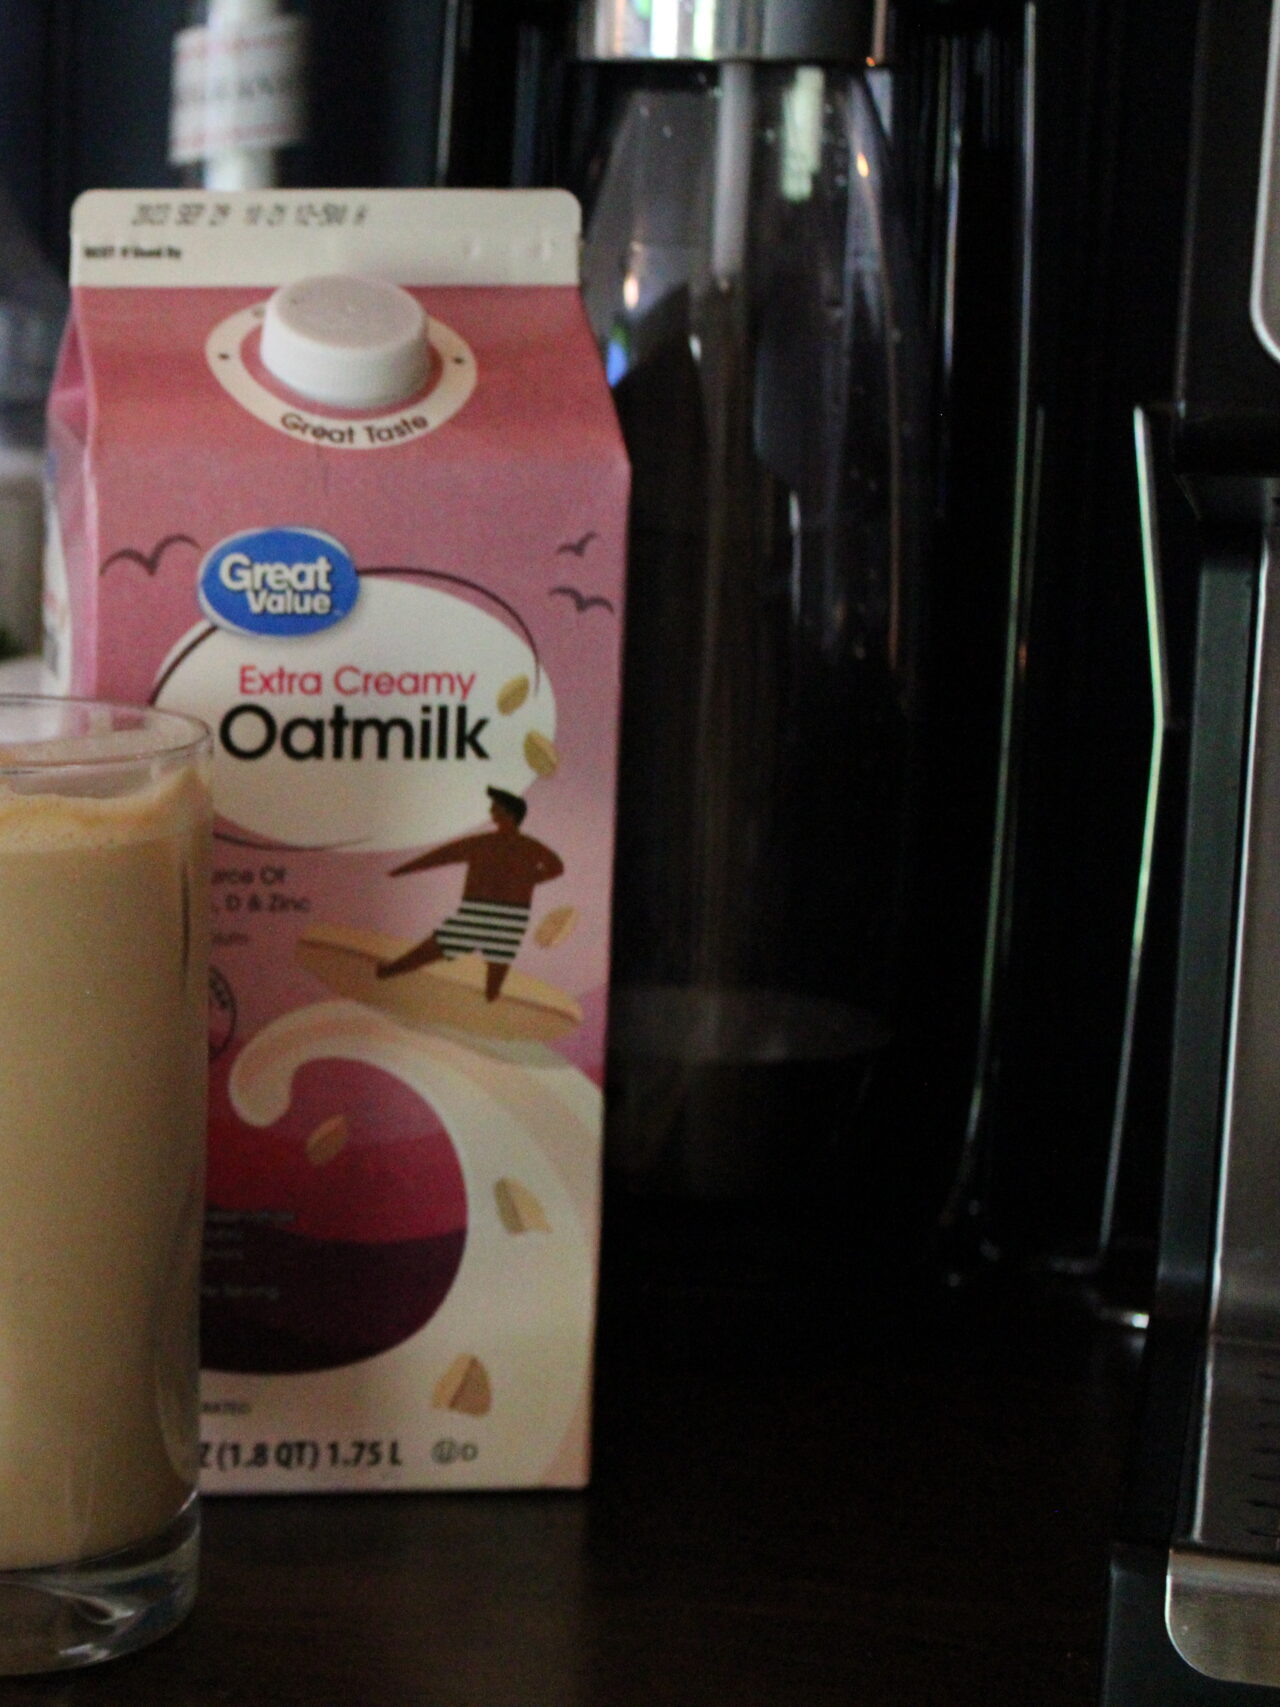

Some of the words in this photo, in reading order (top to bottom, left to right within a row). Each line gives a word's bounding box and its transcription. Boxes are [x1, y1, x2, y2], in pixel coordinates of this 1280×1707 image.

[281, 412, 354, 444] Great
[365, 416, 428, 443] Taste
[220, 553, 333, 591] Great
[246, 588, 332, 614] Value
[239, 665, 323, 695] Extra
[334, 665, 476, 701] Creamy
[220, 703, 491, 761] Oatmilk
[216, 1441, 269, 1471] (1.8
[275, 1441, 320, 1471] QT)
[327, 1441, 383, 1467] 1.75
[391, 1440, 402, 1467] L
